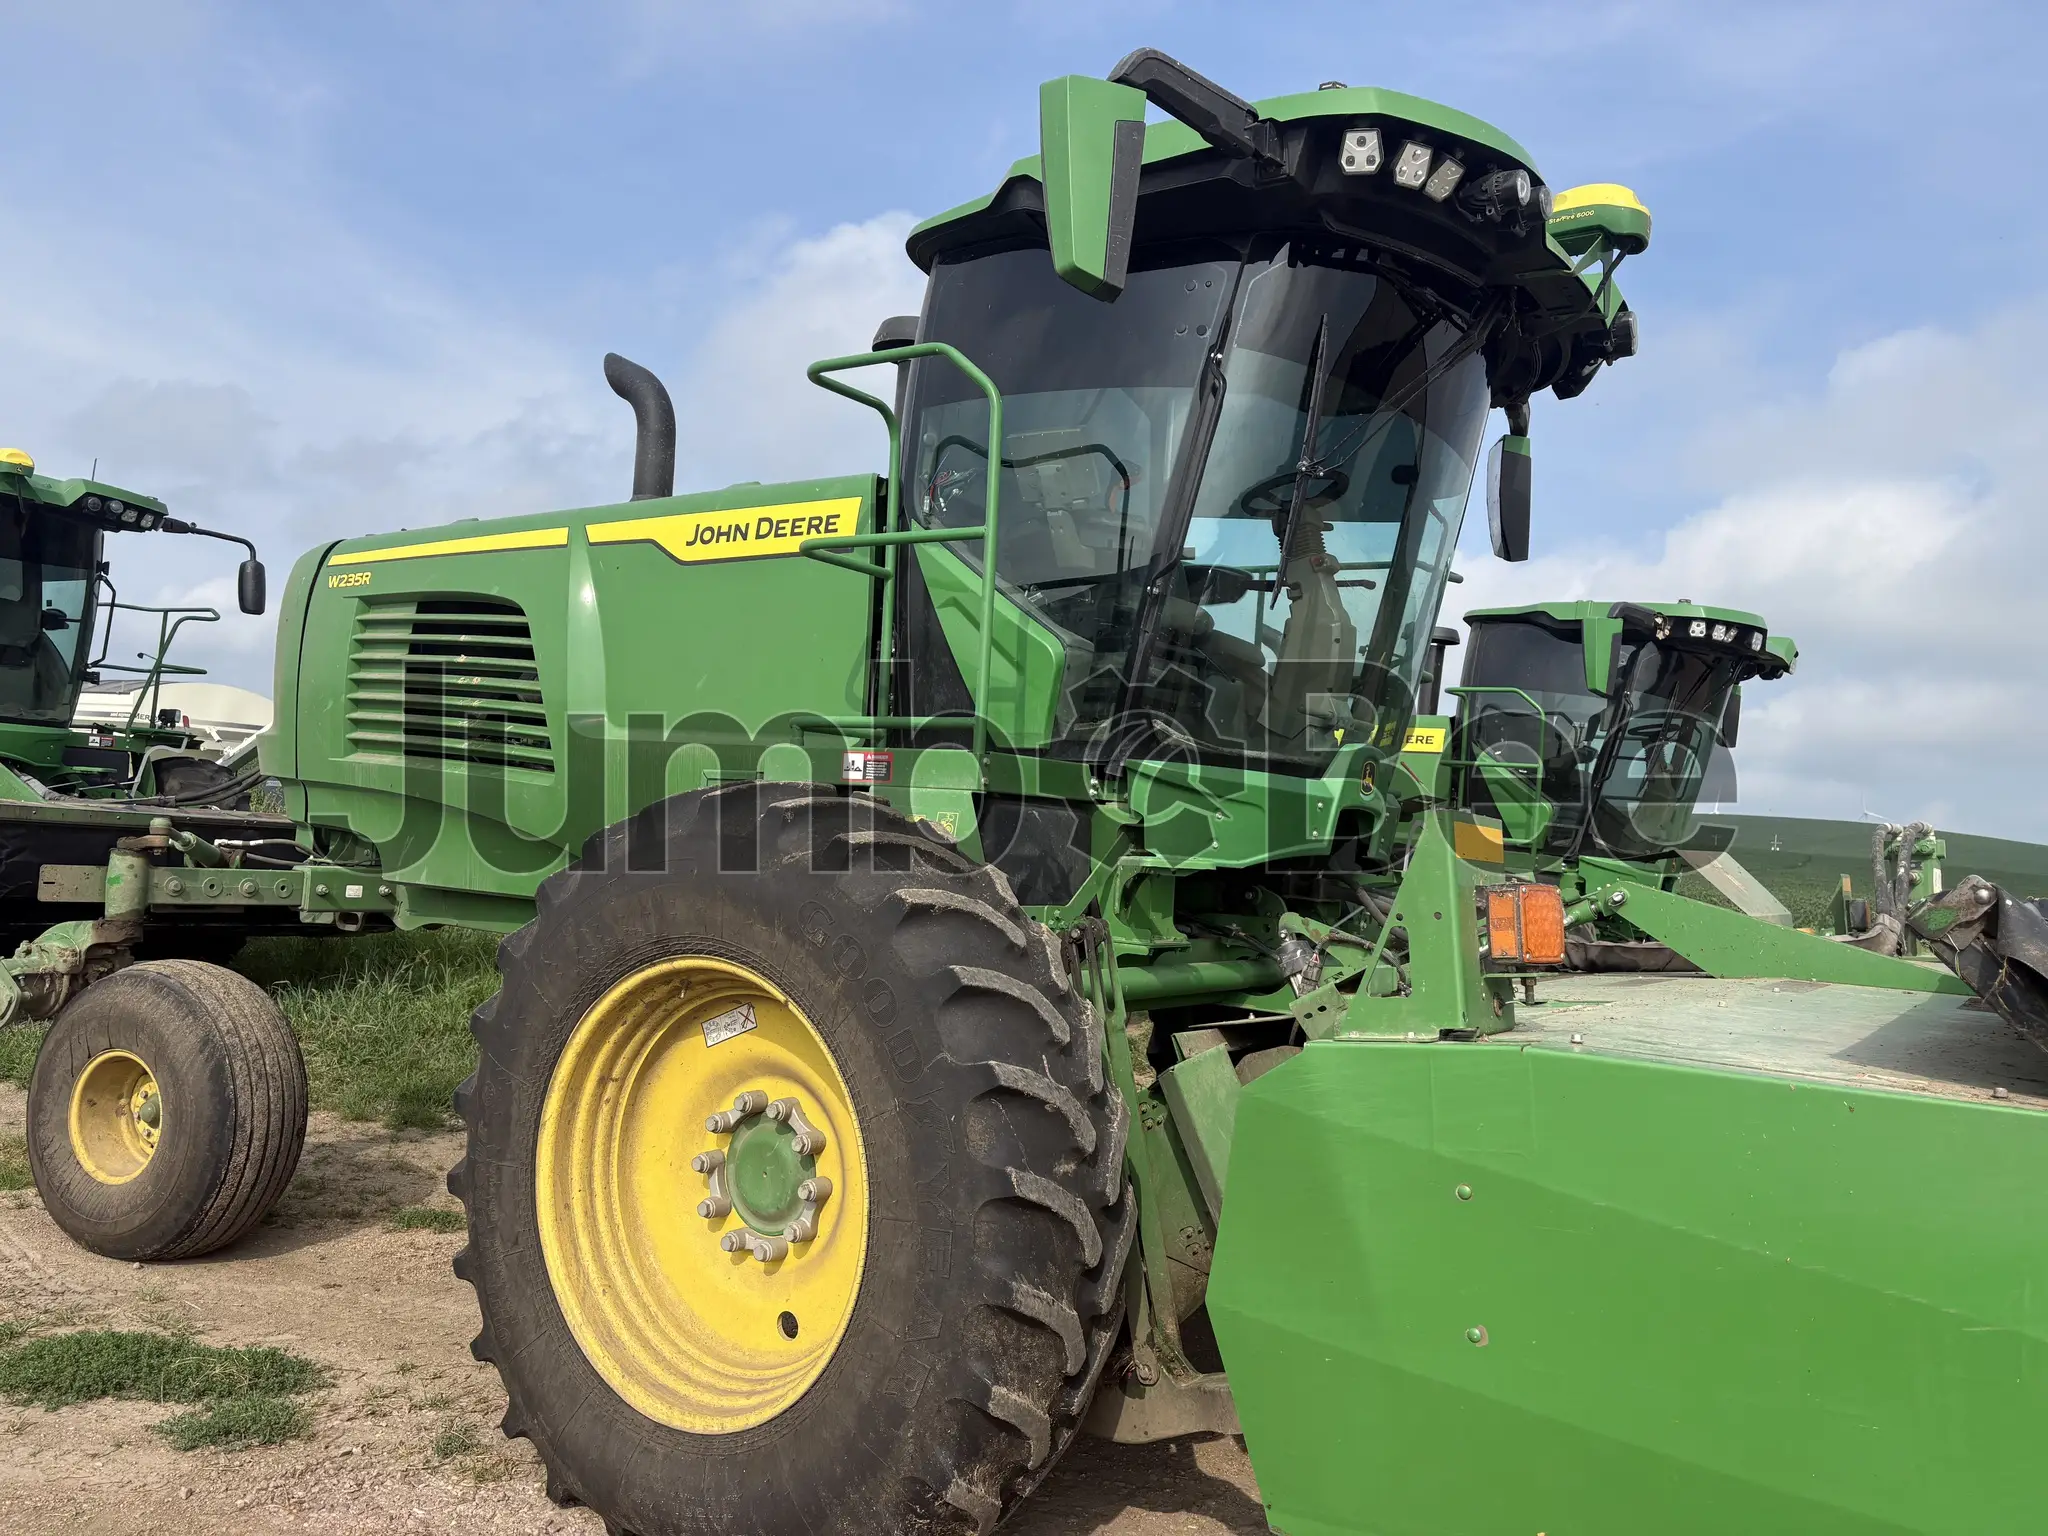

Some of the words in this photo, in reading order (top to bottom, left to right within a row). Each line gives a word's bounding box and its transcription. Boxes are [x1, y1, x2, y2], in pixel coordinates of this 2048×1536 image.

[1576, 210, 1595, 218] 6000
[686, 523, 750, 546] JOHN
[755, 514, 841, 540] DEERE
[328, 571, 372, 588] W235R
